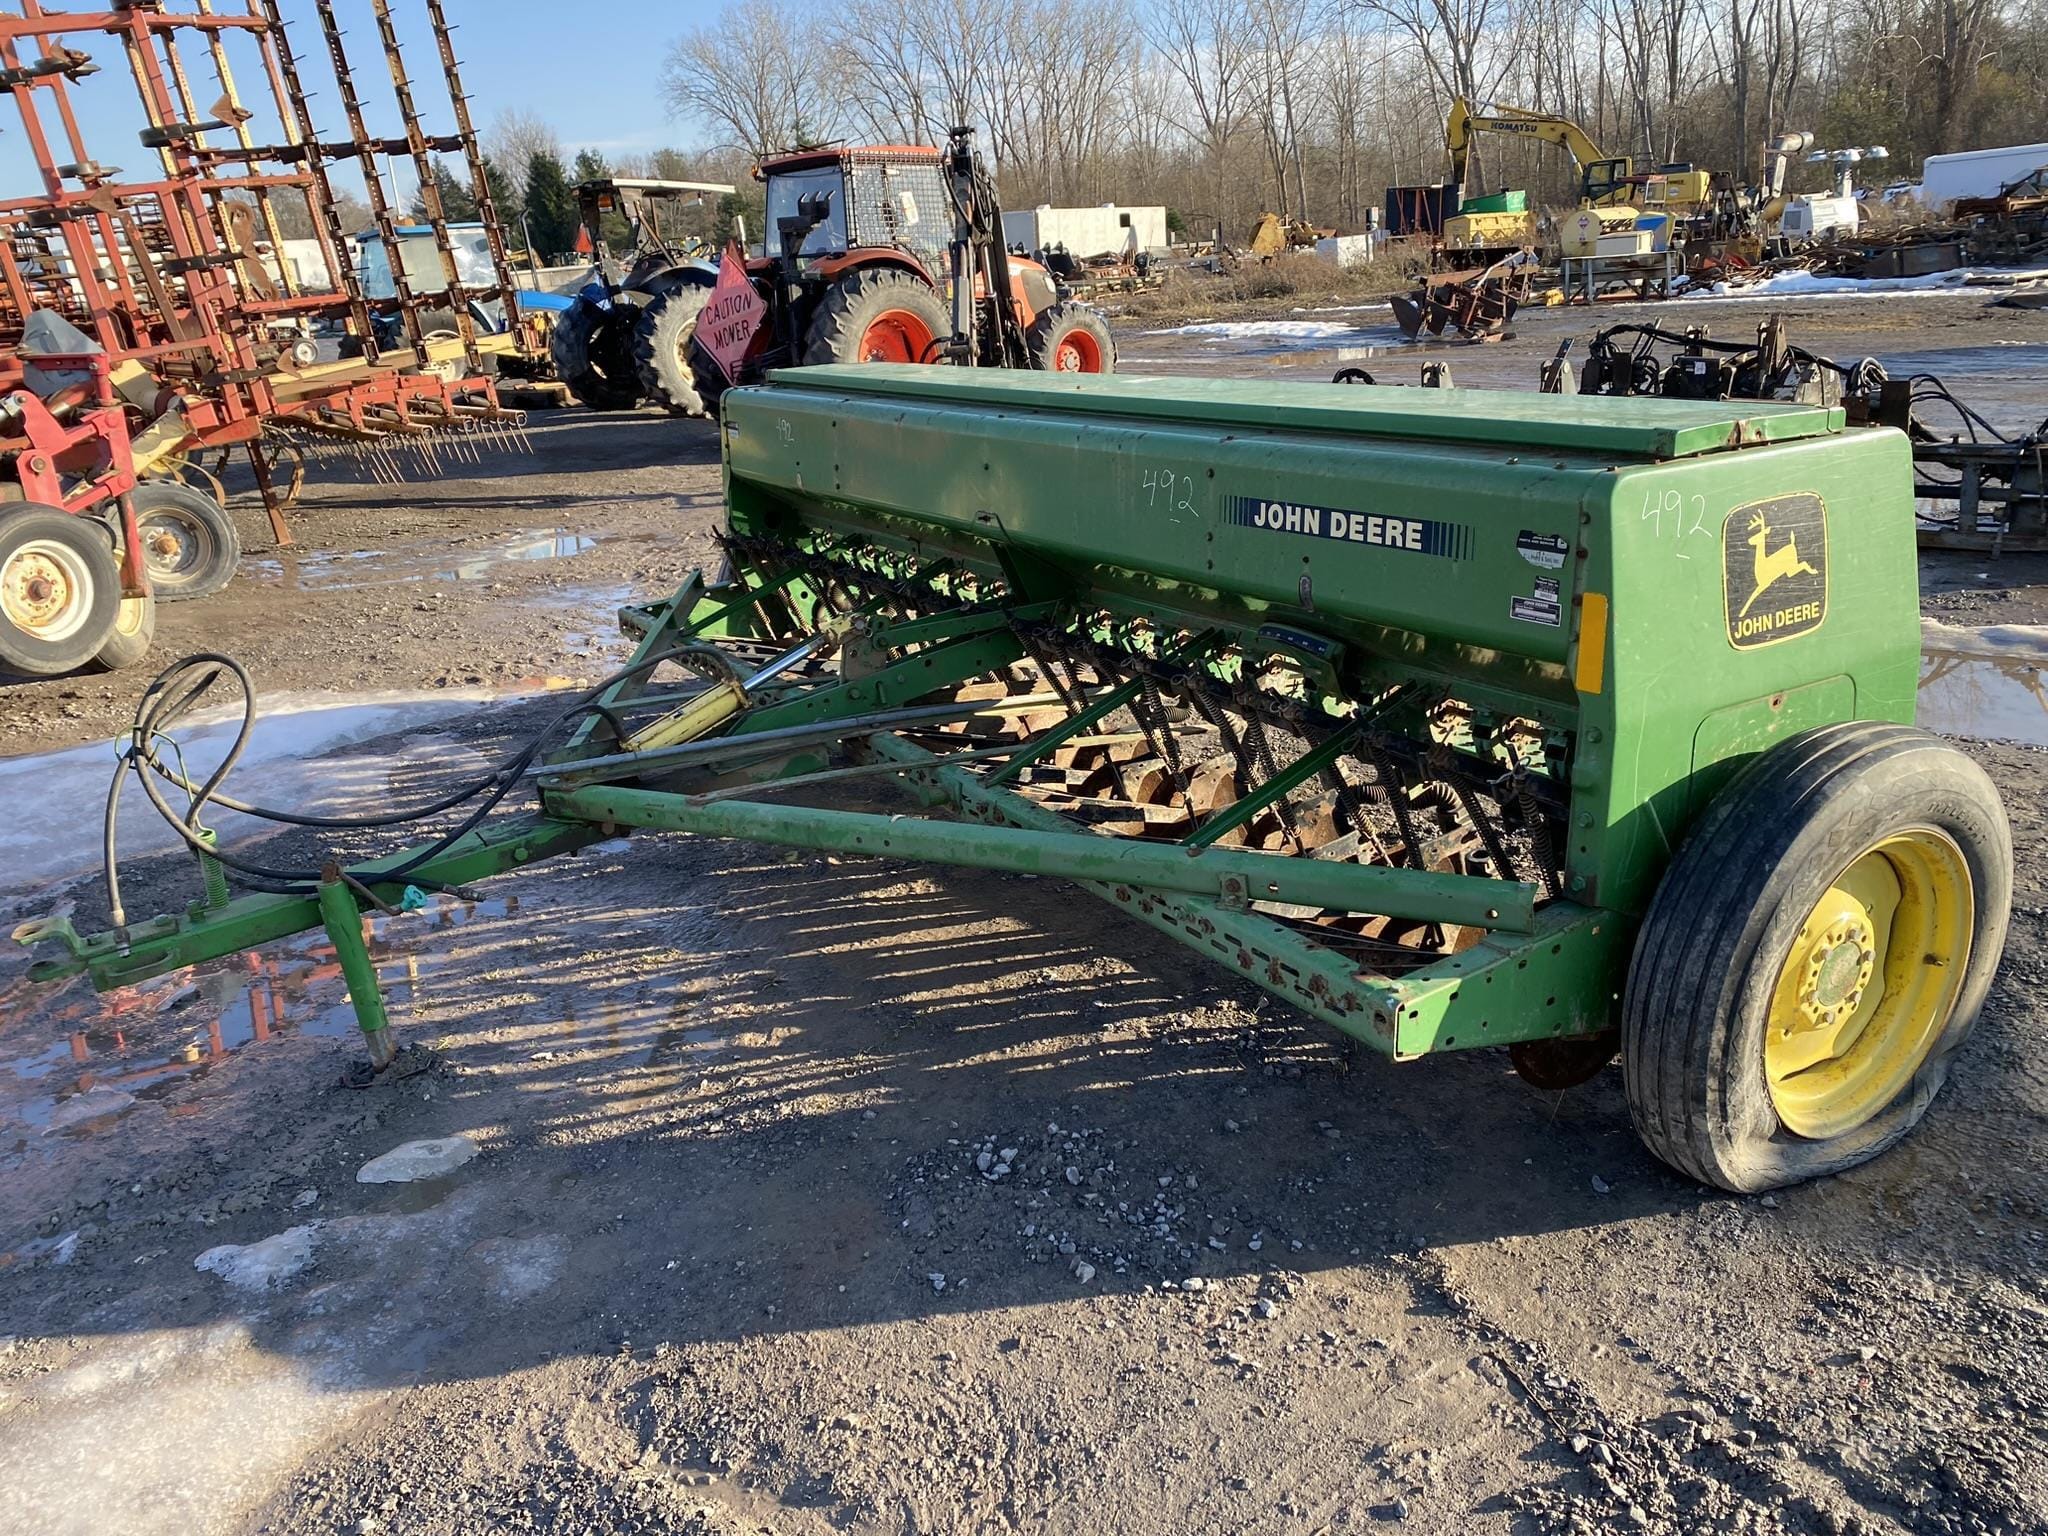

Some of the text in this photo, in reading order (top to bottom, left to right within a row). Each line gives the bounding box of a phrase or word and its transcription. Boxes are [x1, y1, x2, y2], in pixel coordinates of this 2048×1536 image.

[1490, 121, 1538, 132] KOMATSU
[705, 292, 752, 325] CAUTION
[1142, 468, 1200, 518] 492
[1641, 488, 1713, 538] 492
[1253, 501, 1424, 550] JOHN DEERE
[1734, 600, 1820, 640] JOHN DEERE
